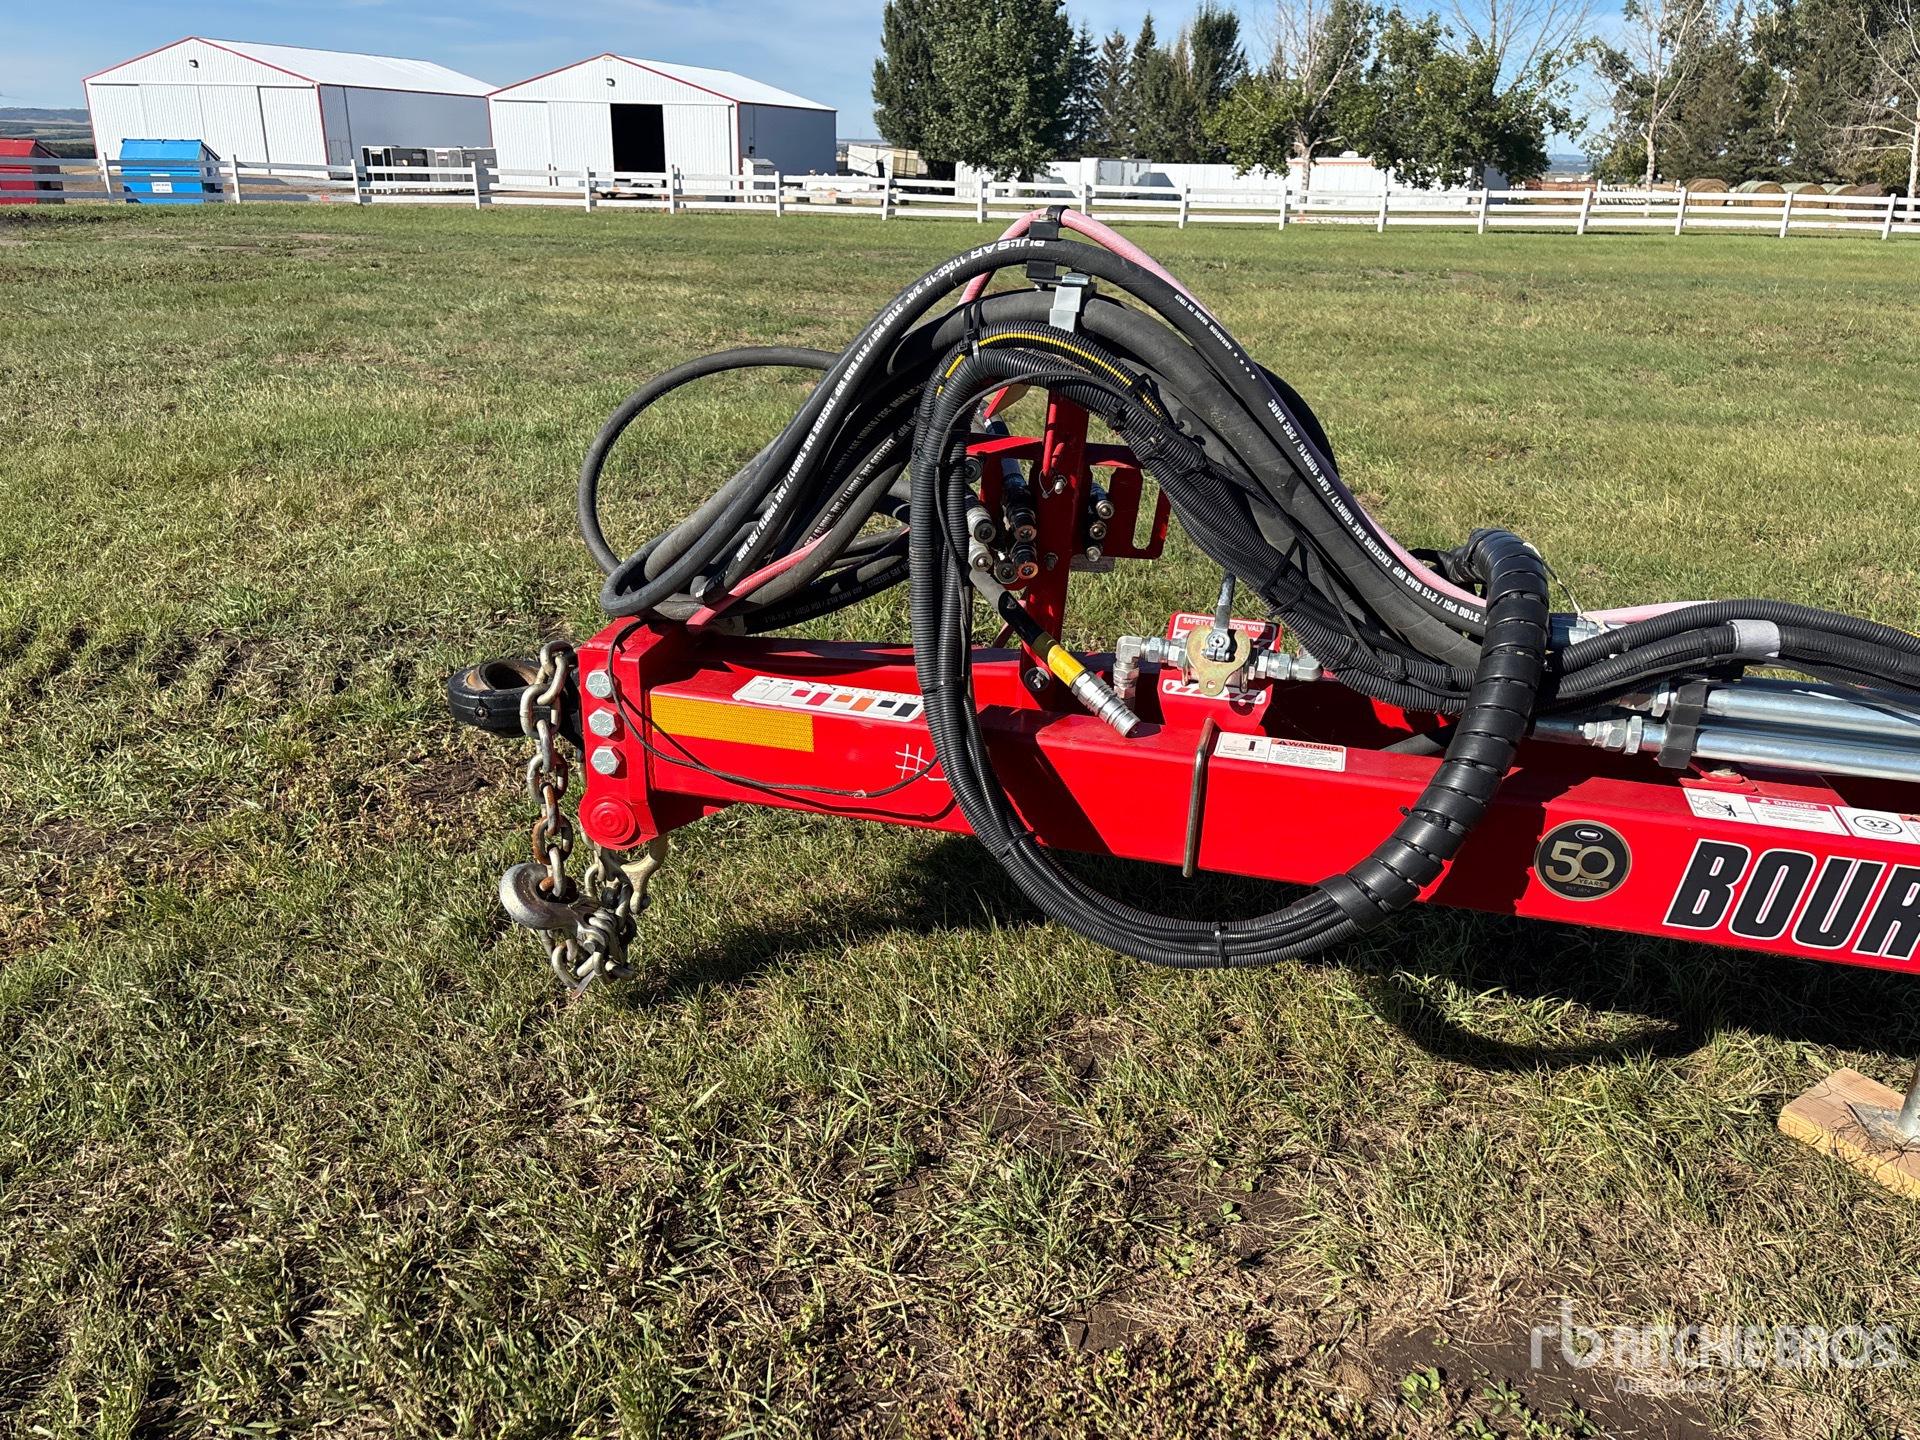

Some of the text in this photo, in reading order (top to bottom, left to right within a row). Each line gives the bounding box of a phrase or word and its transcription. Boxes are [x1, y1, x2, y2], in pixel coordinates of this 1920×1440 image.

[970, 238, 1046, 260] PULSAR
[925, 255, 967, 287] 112CC-12
[1174, 294, 1189, 307] ITALY
[1187, 304, 1196, 313] IN
[883, 303, 904, 327] 3100
[1193, 310, 1209, 326] MADE
[870, 324, 885, 346] PSI
[855, 344, 870, 363] 215
[843, 362, 858, 381] BAR
[834, 379, 847, 397] WP
[812, 397, 837, 435] EXCEEDS
[1282, 421, 1297, 440] 2SC
[804, 431, 816, 452] SAE
[789, 451, 807, 483] 100R17
[1297, 443, 1320, 476] 100R16
[1316, 473, 1331, 492] SAE
[775, 487, 787, 503] SAE
[1330, 495, 1354, 526] 100R17
[1352, 523, 1366, 539] SAE
[1364, 537, 1393, 568] EXCEEDS
[1392, 566, 1407, 578] WP
[1405, 578, 1423, 593] BAR
[1421, 588, 1438, 602] 215
[1442, 601, 1458, 614] PSI
[1459, 606, 1481, 623] 3100
[1182, 617, 1209, 627] SAFETY
[1247, 624, 1269, 633] VALVE
[1288, 740, 1339, 752] WARNING
[1773, 800, 1818, 810] DANGER
[1863, 818, 1893, 829] 32
[1545, 840, 1616, 883] 50
[1578, 878, 1605, 888] YEARS
[1661, 838, 1920, 960] BOUR
